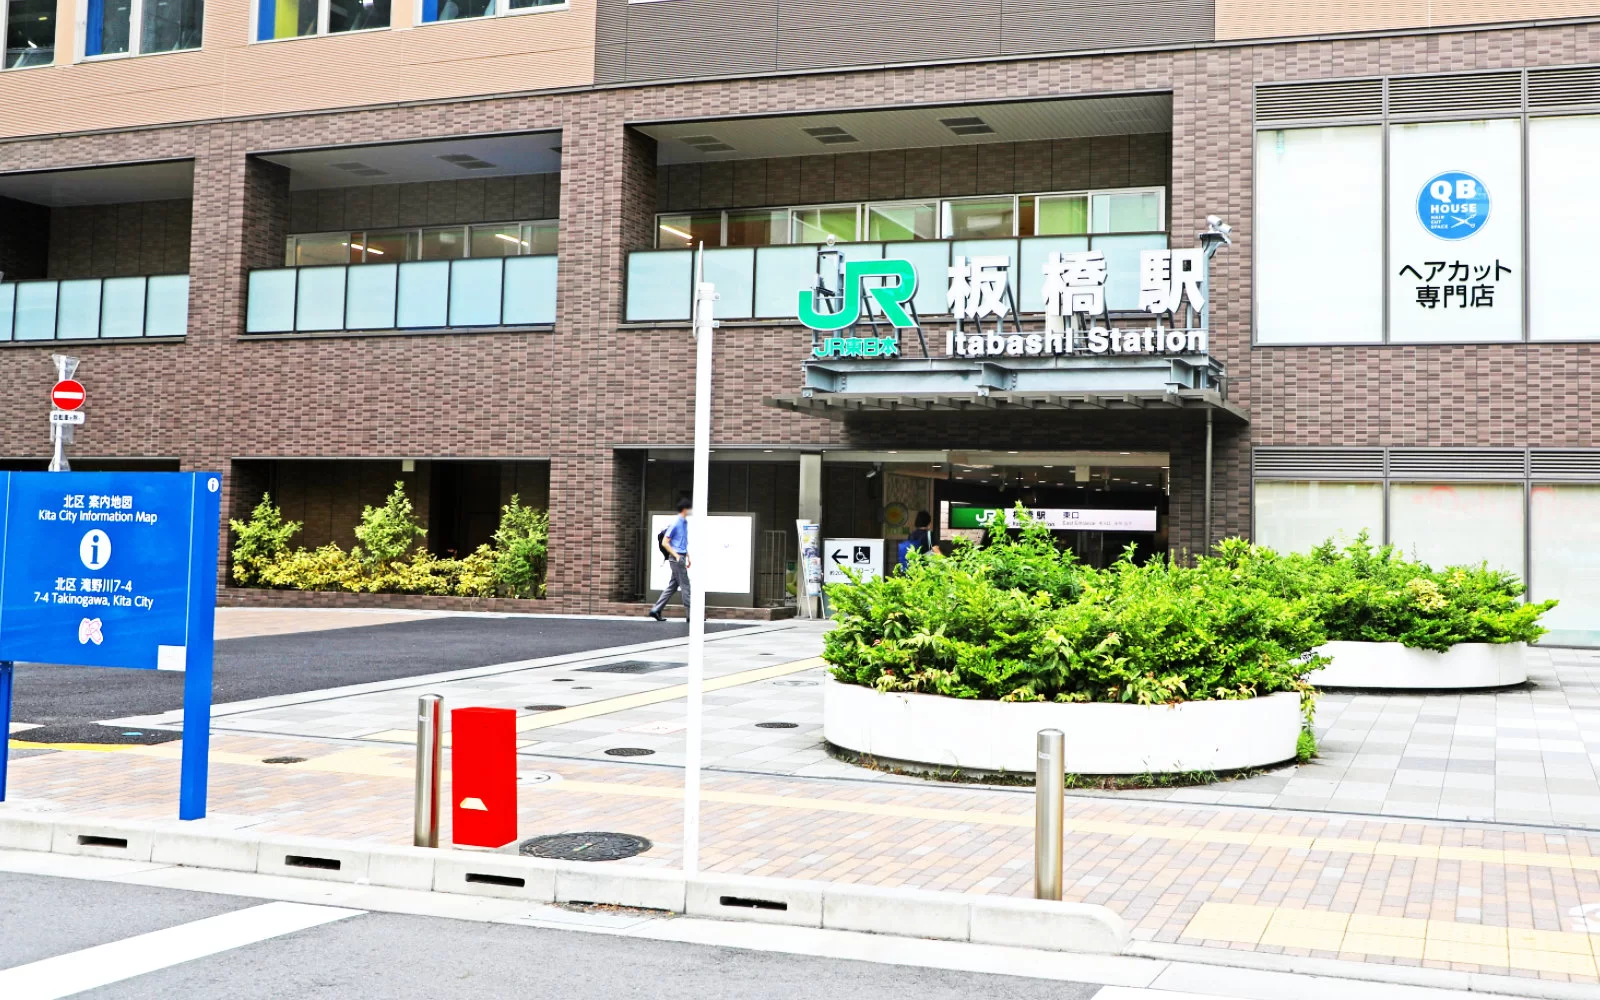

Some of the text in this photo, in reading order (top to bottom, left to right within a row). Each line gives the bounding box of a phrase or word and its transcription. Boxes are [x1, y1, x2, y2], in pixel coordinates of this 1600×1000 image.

[1430, 179, 1477, 203] QB
[1430, 203, 1477, 214] HOUSE
[1399, 259, 1512, 282] ヘアカット
[946, 248, 1205, 319] 板橋駅
[798, 259, 919, 331] JR
[1416, 284, 1495, 309] 専門店
[814, 336, 899, 357] JR東日本
[945, 326, 1207, 356] Itabashi Station
[63, 494, 133, 509] 北区 案内地図
[38, 510, 158, 525] Kita City Information Map
[54, 577, 133, 593] 北区 滝野川7-4
[34, 591, 154, 611] 7-4 Takinogawa, Kita City
